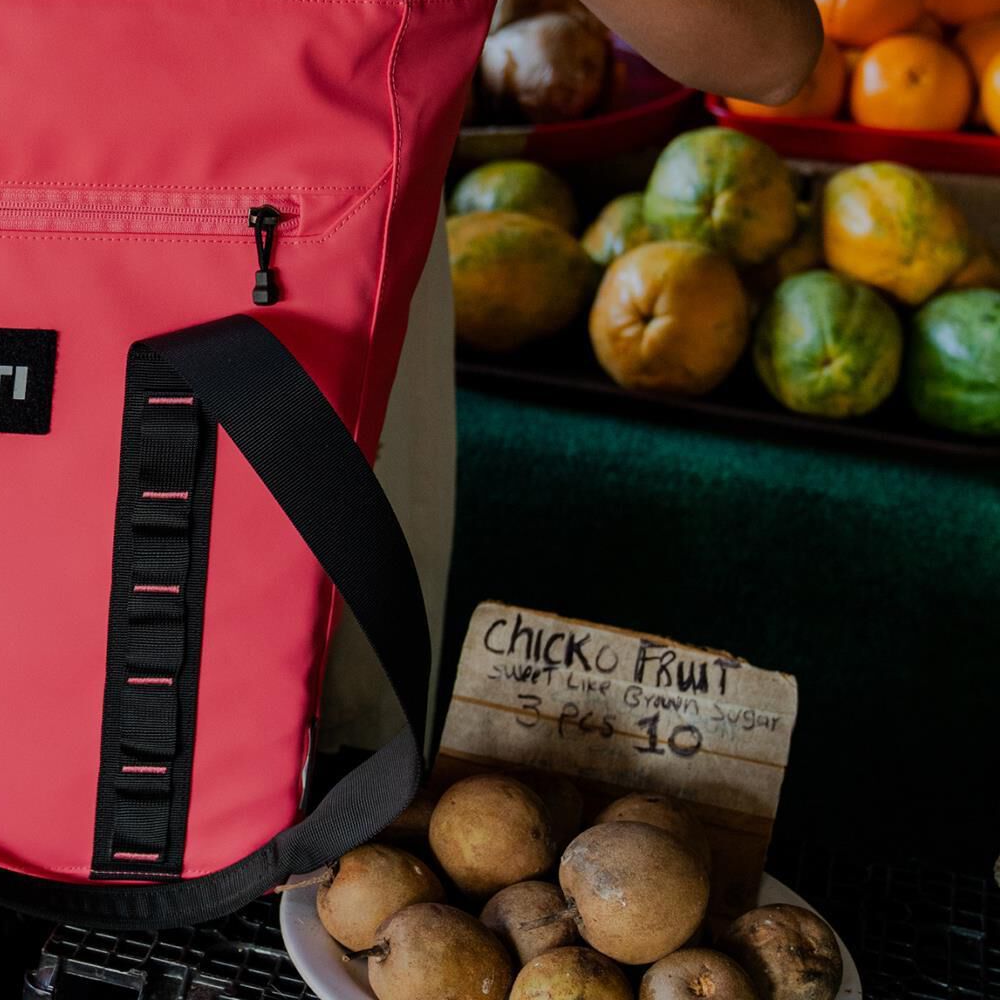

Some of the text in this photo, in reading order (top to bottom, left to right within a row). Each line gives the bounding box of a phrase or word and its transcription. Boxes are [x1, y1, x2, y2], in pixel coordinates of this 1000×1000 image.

[634, 639, 741, 694] FRUIT
[515, 694, 542, 728] 3
[634, 710, 702, 758] 10
[623, 685, 700, 715] Brown
[709, 702, 783, 730] Sugar
